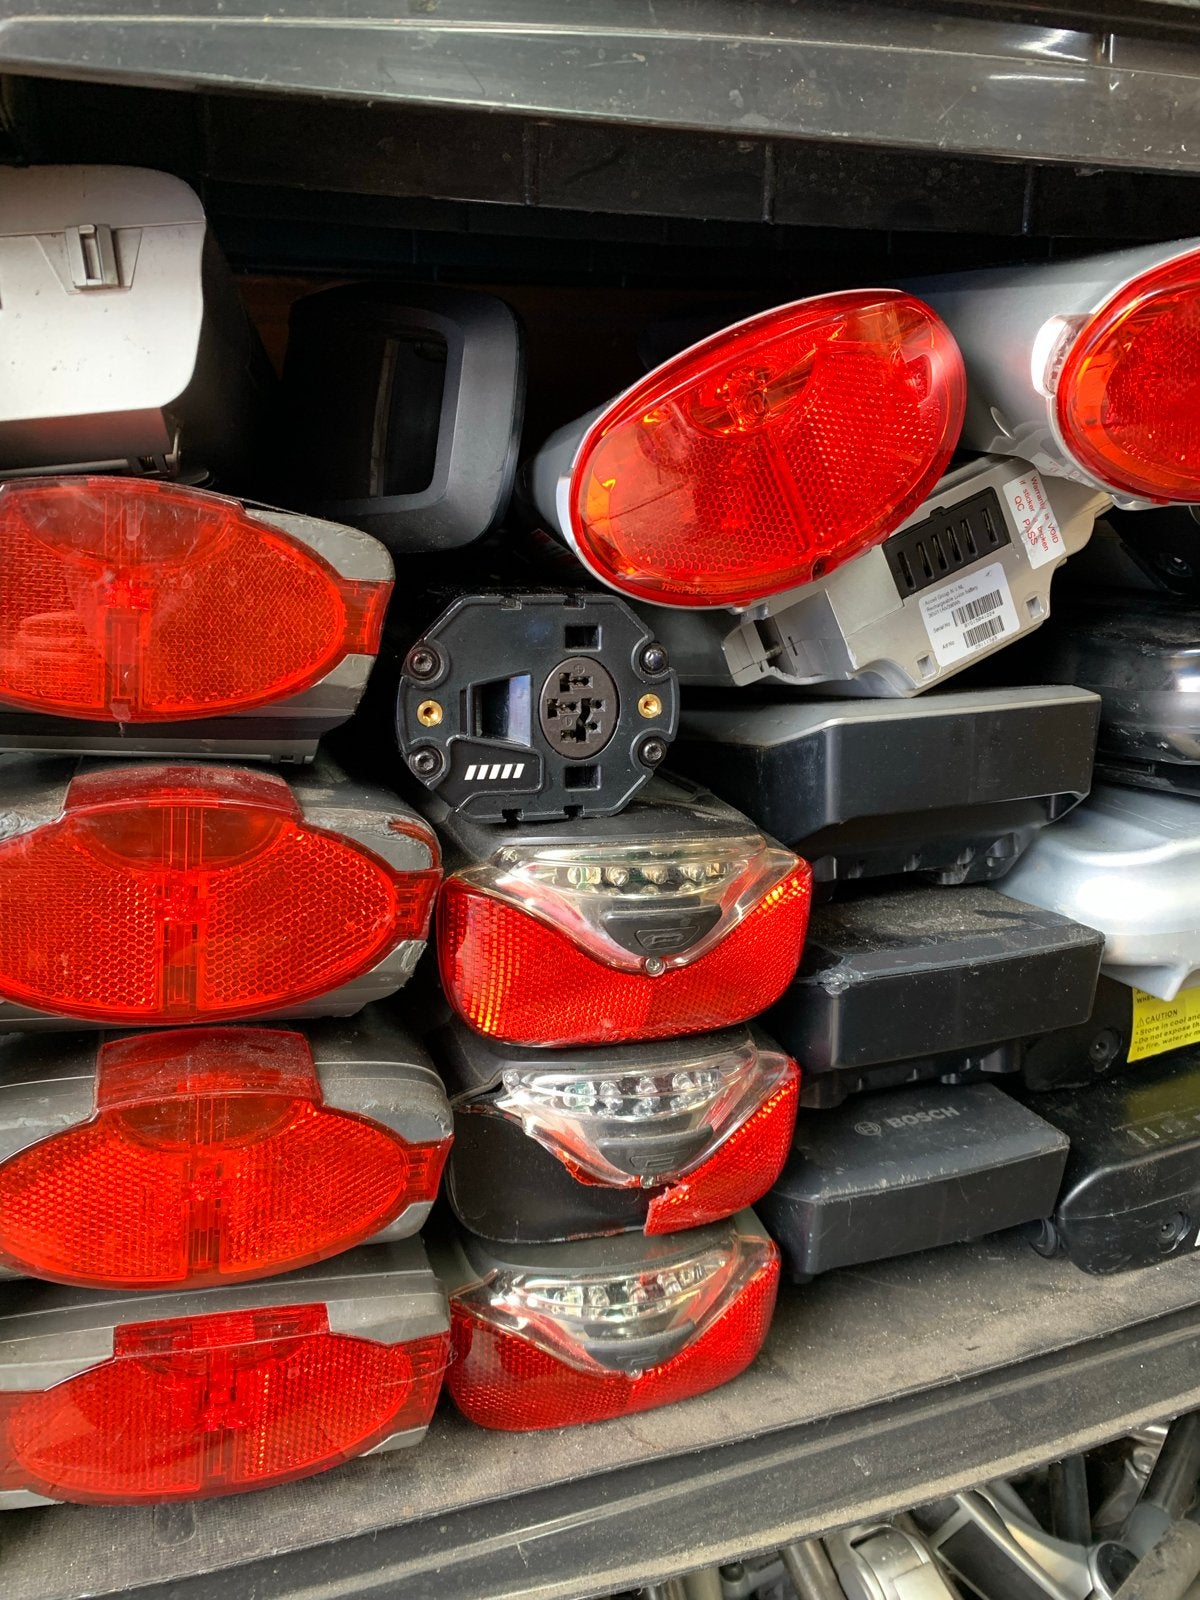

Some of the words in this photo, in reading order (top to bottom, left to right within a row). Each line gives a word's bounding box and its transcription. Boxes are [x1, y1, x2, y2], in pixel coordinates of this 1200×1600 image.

[1014, 495, 1025, 512] QC
[1022, 518, 1039, 546] PASS
[1023, 488, 1035, 512] sticker
[1037, 525, 1049, 552] broken
[1031, 475, 1047, 510] Warranty
[1047, 523, 1059, 544] VOID
[1145, 1009, 1178, 1025] CAUTION
[1161, 1022, 1169, 1030] in
[1169, 1016, 1187, 1027] cool
[1138, 1036, 1149, 1044] Do
[1150, 1032, 1163, 1040] not
[1163, 1025, 1191, 1037] expose
[1192, 1021, 1200, 1029] th
[1162, 1034, 1183, 1045] water
[885, 1106, 960, 1129] BOSCH
